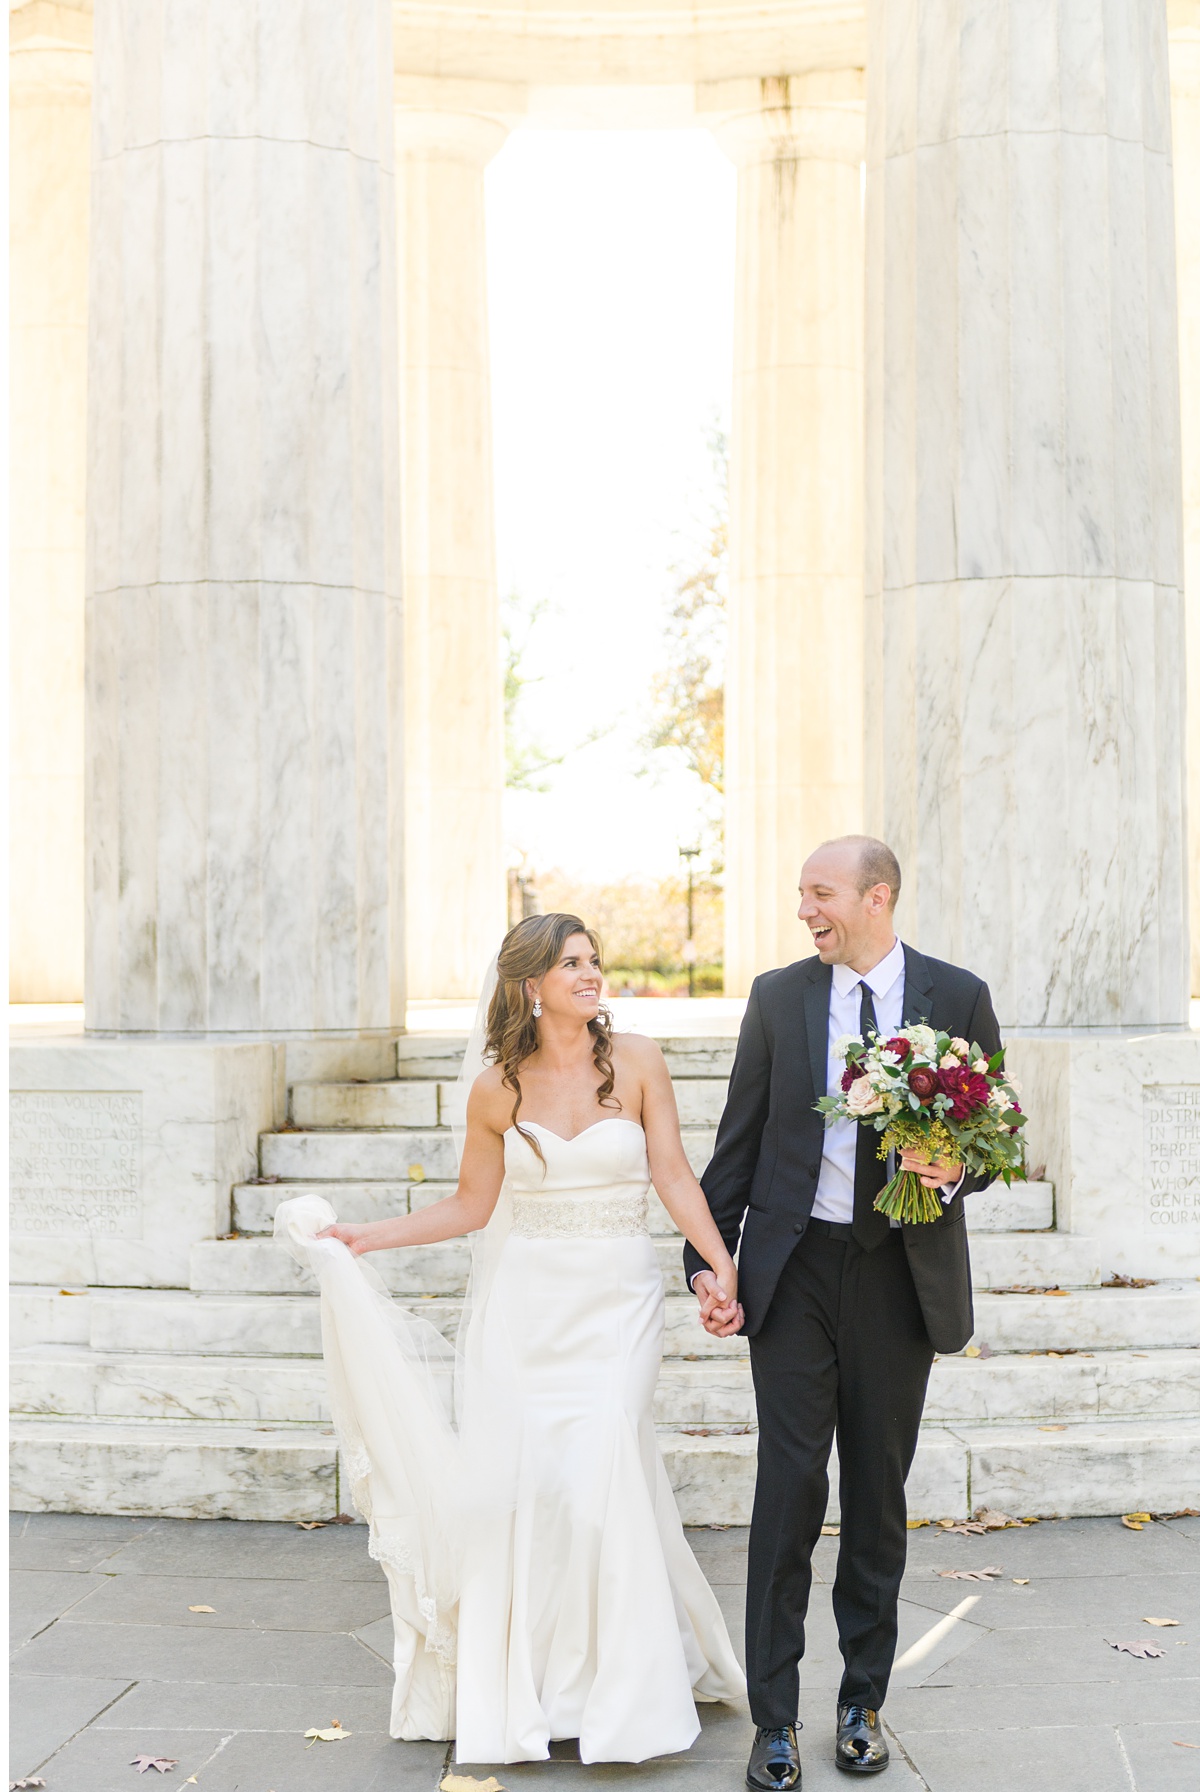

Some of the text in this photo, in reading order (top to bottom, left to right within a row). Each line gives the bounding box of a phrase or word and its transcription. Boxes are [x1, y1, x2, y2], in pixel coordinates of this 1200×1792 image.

[33, 1096, 57, 1110] THE
[64, 1096, 136, 1110] VOLUNTARY
[90, 1112, 102, 1126] IT
[107, 1112, 138, 1126] WAS
[1150, 1109, 1200, 1123] DISTRI
[39, 1127, 102, 1141] HUNDRED
[111, 1128, 138, 1141] AND
[1150, 1126, 1165, 1140] IN
[30, 1142, 109, 1156] PRESIDENT
[118, 1143, 137, 1157] OF
[112, 1159, 137, 1173] ARE
[1151, 1160, 1170, 1174] TO
[66, 1173, 137, 1188] THOUSAND
[1151, 1177, 1188, 1190] WHO
[32, 1188, 77, 1202] STATES
[81, 1189, 138, 1203] ENTERED
[24, 1203, 57, 1216] ARMS
[93, 1204, 138, 1218] SERVED
[24, 1218, 66, 1232] COAST
[1150, 1211, 1200, 1225] COURA
